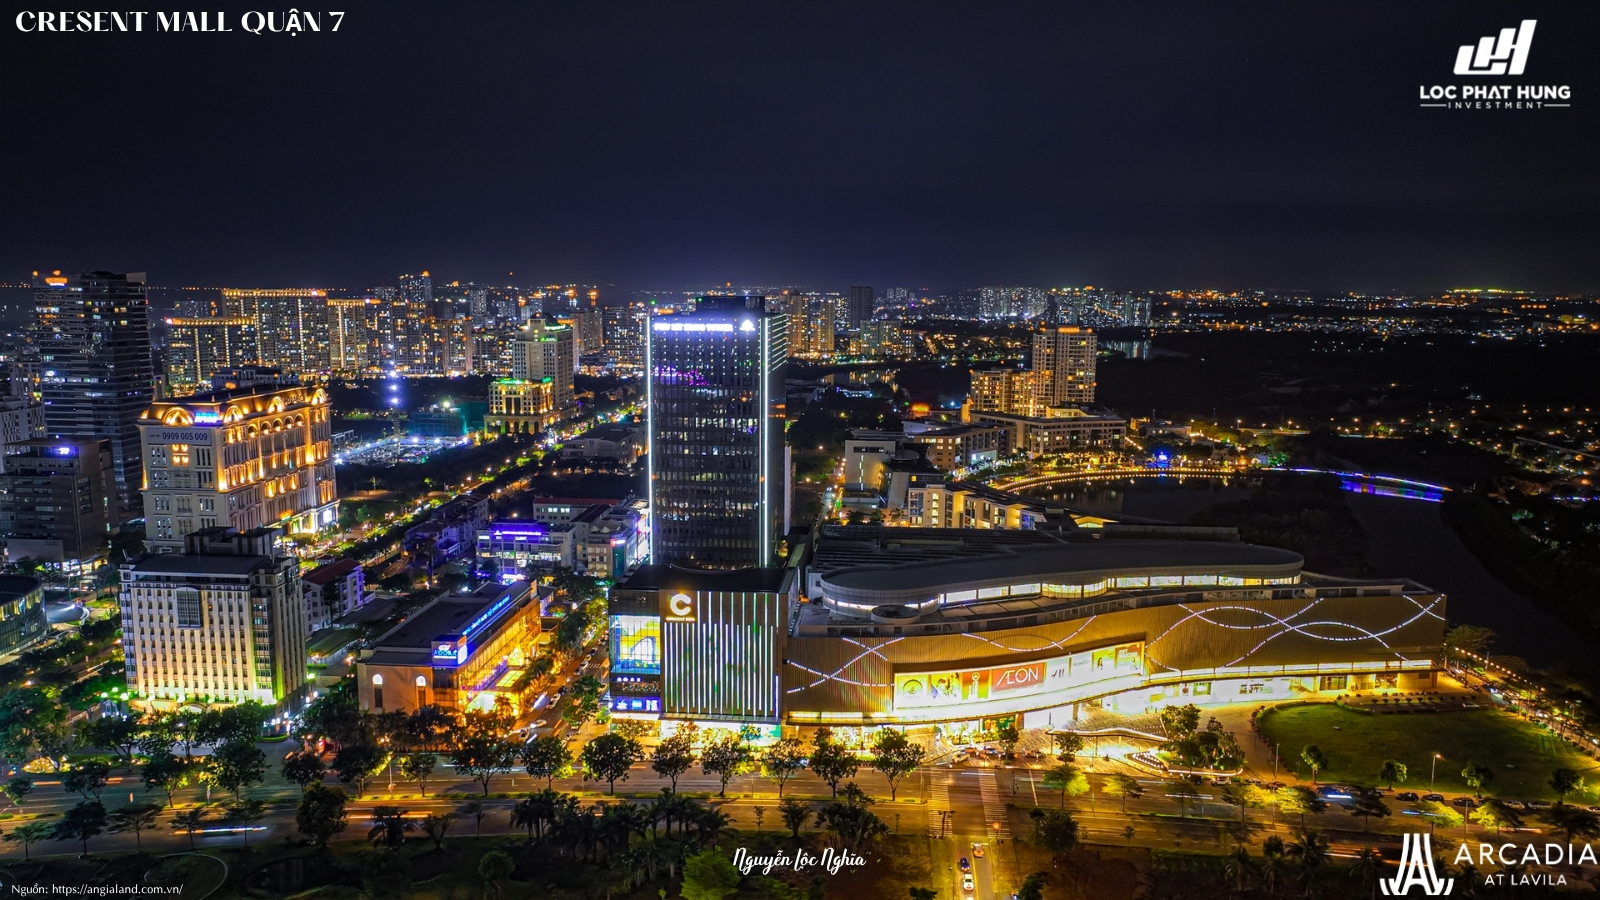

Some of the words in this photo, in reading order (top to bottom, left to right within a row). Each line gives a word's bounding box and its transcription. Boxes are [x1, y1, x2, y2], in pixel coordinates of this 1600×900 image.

[162, 432, 179, 440] 0909
[181, 432, 194, 441] 005
[195, 433, 208, 441] 009
